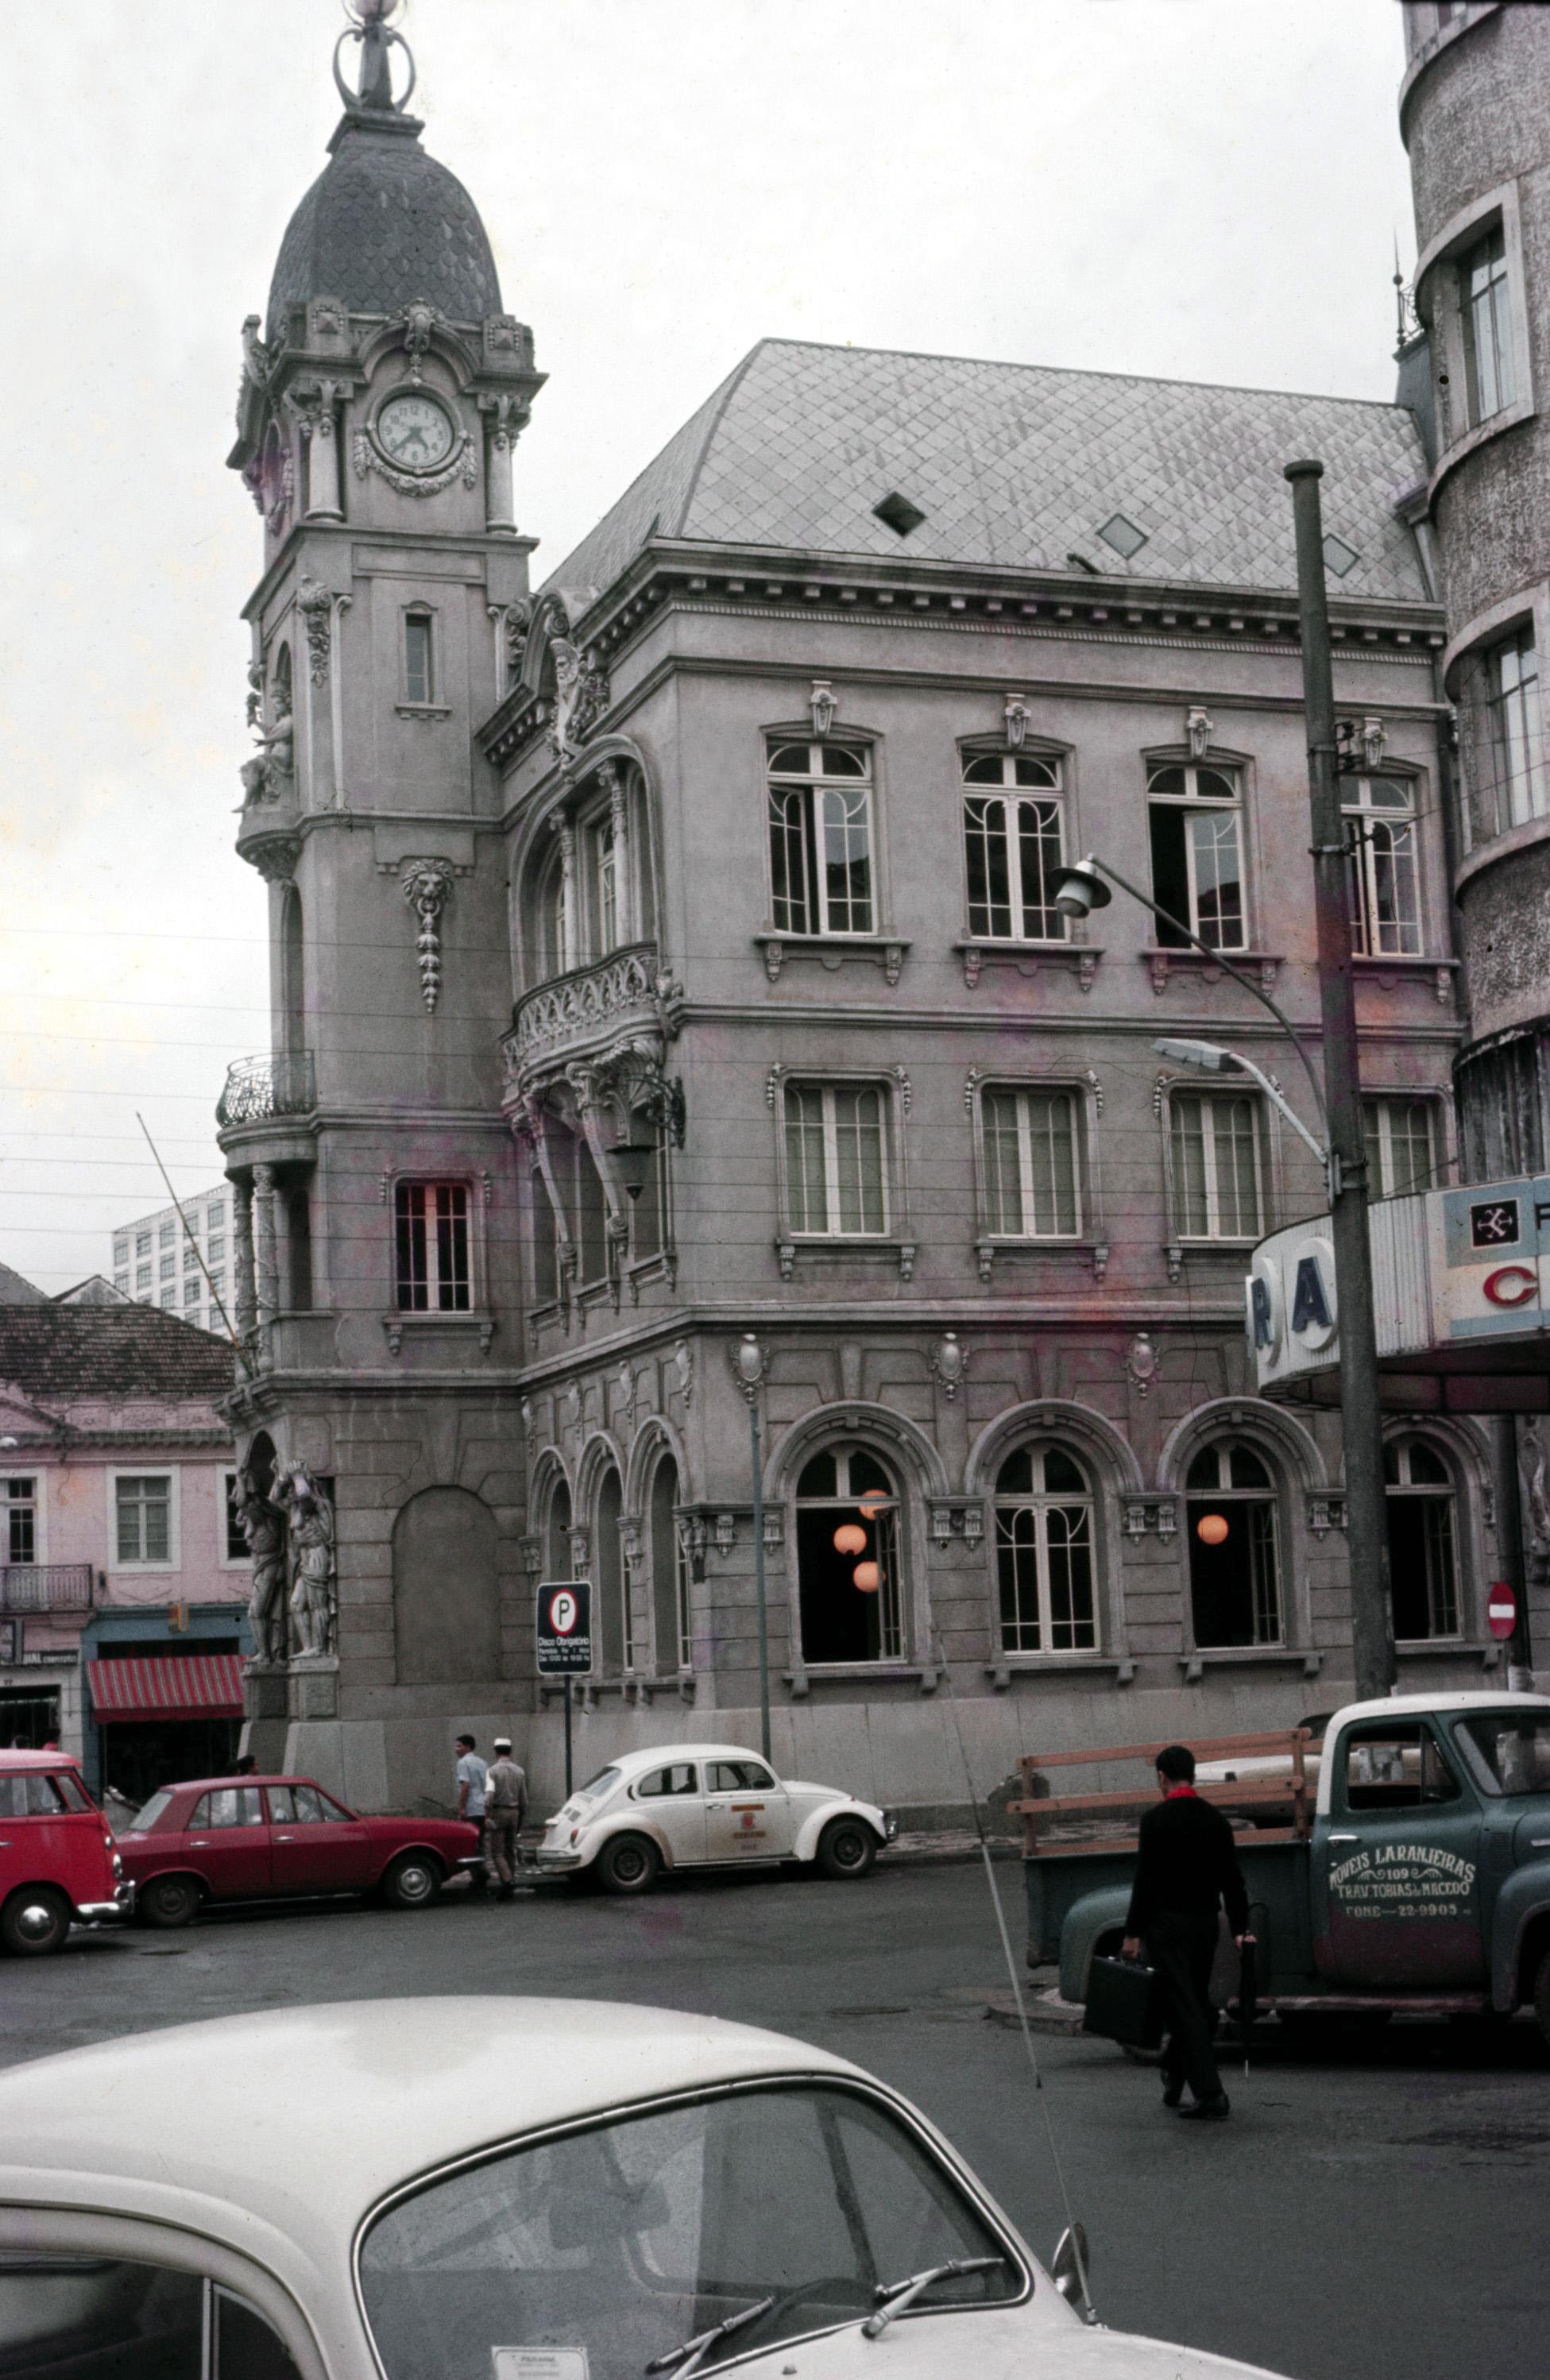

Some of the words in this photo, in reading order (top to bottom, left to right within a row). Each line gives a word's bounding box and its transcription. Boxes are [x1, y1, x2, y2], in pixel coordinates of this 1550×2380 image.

[411, 405, 419, 415] 12
[412, 450, 419, 462] 6
[559, 1599, 570, 1625] P
[1329, 1852, 1370, 1890] MOVEIS
[1374, 1845, 1476, 1883] LARANJEIRAS
[1386, 1868, 1409, 1880] 109
[1372, 1883, 1412, 1898] TOBIAS
[1422, 1881, 1470, 1896] MACEDO
